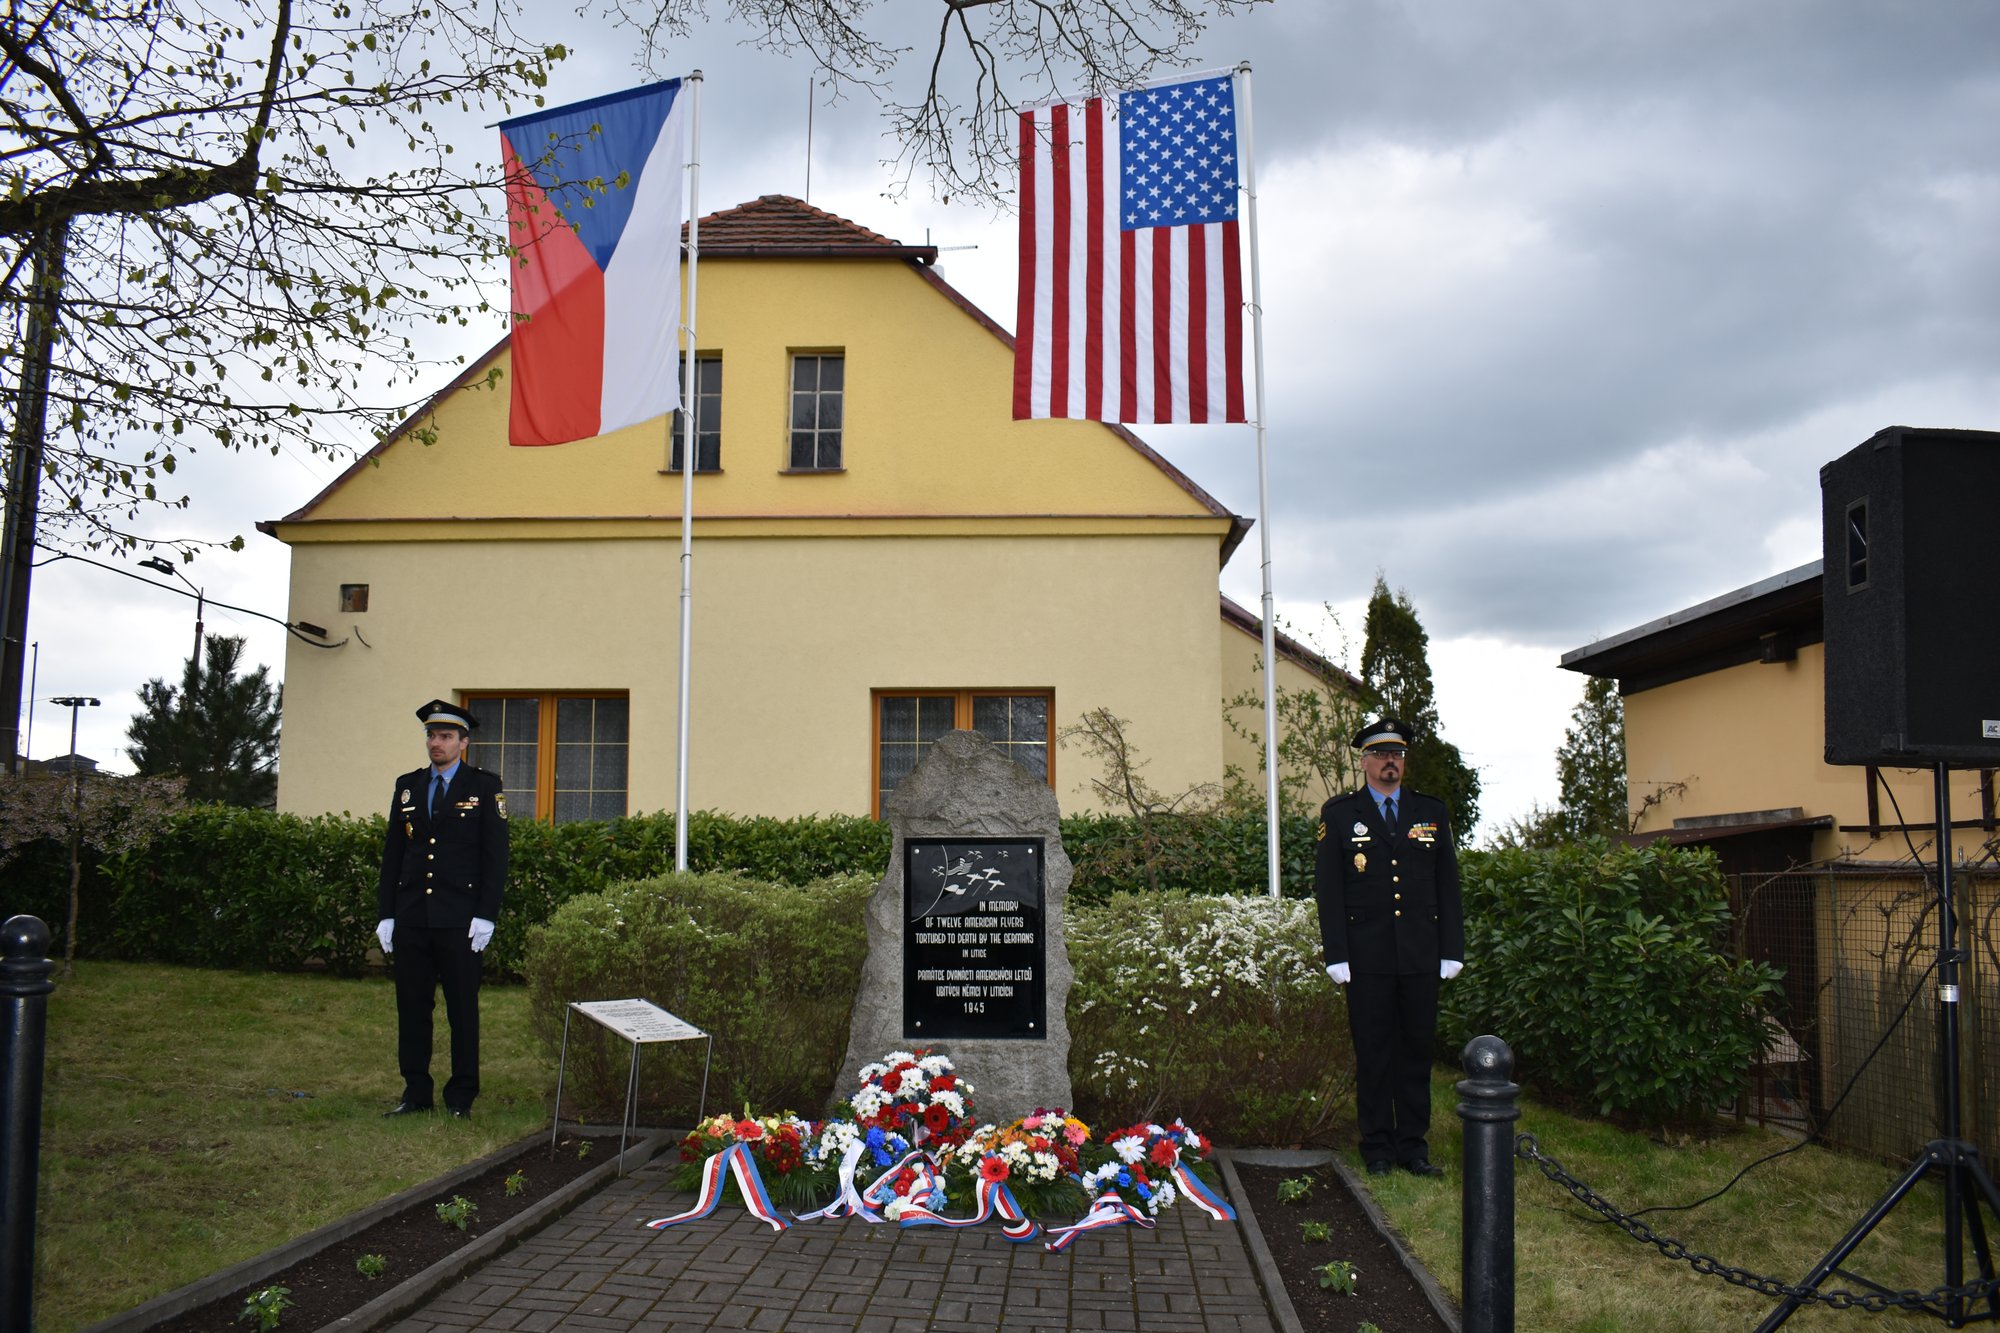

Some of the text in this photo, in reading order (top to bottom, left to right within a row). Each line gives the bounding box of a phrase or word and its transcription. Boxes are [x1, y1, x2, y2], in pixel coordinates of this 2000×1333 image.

[979, 901, 1019, 911] IN MEMORY
[925, 917, 1024, 928] OF TWELVE AMERICAN FLYERS
[915, 933, 1034, 944] TORTURED TO DEATH BY THE GERMANS
[962, 949, 987, 958] IN LITICE
[917, 966, 1032, 981] PAMÁTCE DVANÁCTI AMERICKÝCH LETCŮ
[962, 984, 981, 997] NĚMCI
[983, 986, 988, 997] V
[963, 1002, 985, 1013] 1945
